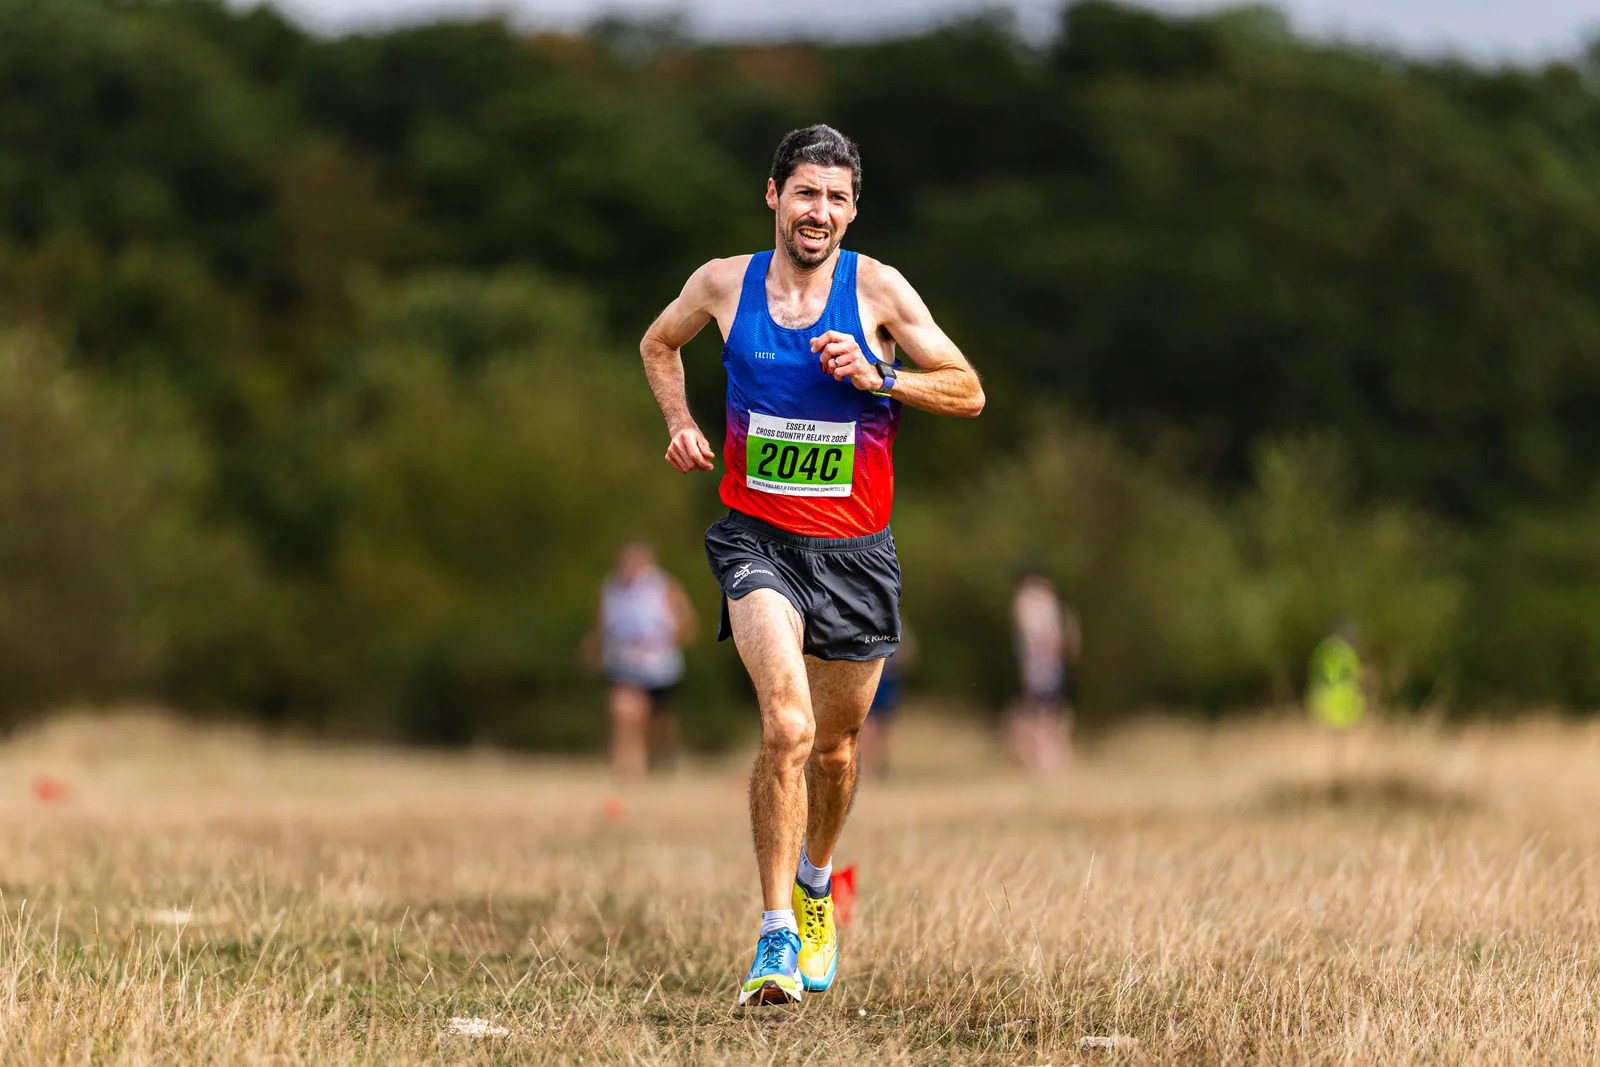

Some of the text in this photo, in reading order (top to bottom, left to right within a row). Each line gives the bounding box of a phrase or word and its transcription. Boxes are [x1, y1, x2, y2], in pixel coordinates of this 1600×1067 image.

[754, 351, 776, 360] TACTIC
[785, 422, 816, 432] ESSEX AA
[755, 427, 775, 437] CROSS
[775, 430, 805, 441] COUNTRY
[805, 433, 831, 443] RELAYS
[757, 442, 843, 482] 204C
